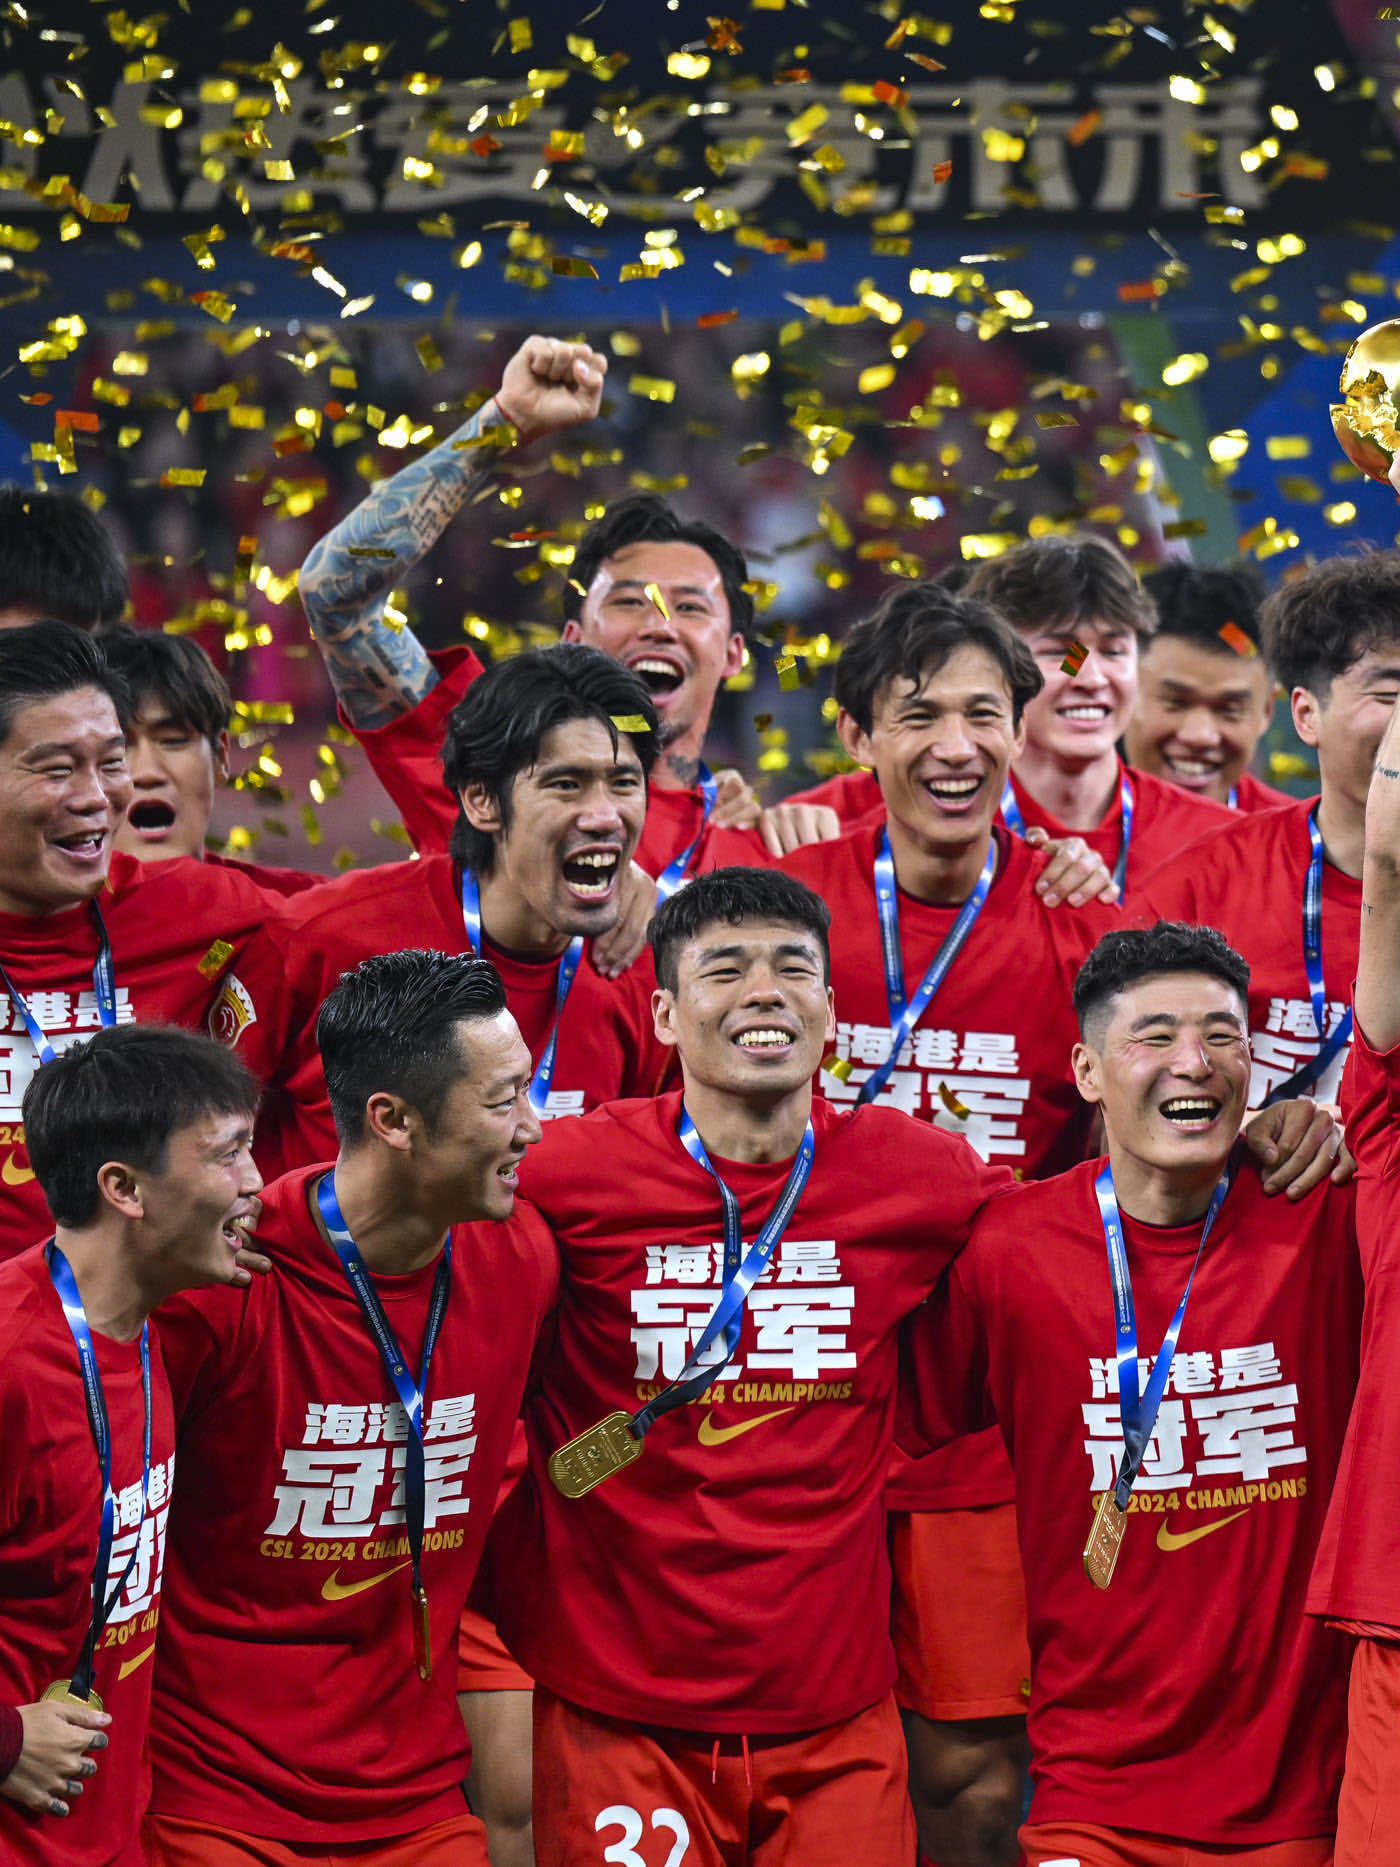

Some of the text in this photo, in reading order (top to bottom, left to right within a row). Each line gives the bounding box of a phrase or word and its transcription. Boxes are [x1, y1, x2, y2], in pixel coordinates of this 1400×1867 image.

[0, 986, 137, 1032] 港是
[836, 1022, 1020, 1074] 海港是
[630, 1286, 857, 1381] 冠军
[732, 1382, 853, 1404] CHAMPIONS
[1089, 1341, 1284, 1399] 海港是
[301, 1393, 476, 1445] 海港是
[1080, 1384, 1309, 1492] 冠军
[263, 1434, 479, 1538] 冠军
[1126, 1493, 1181, 1514] 2024
[1185, 1477, 1308, 1511] CHAMPIONS
[260, 1539, 294, 1560] CSL
[300, 1541, 356, 1561] 2024
[594, 1804, 690, 1867] 32
